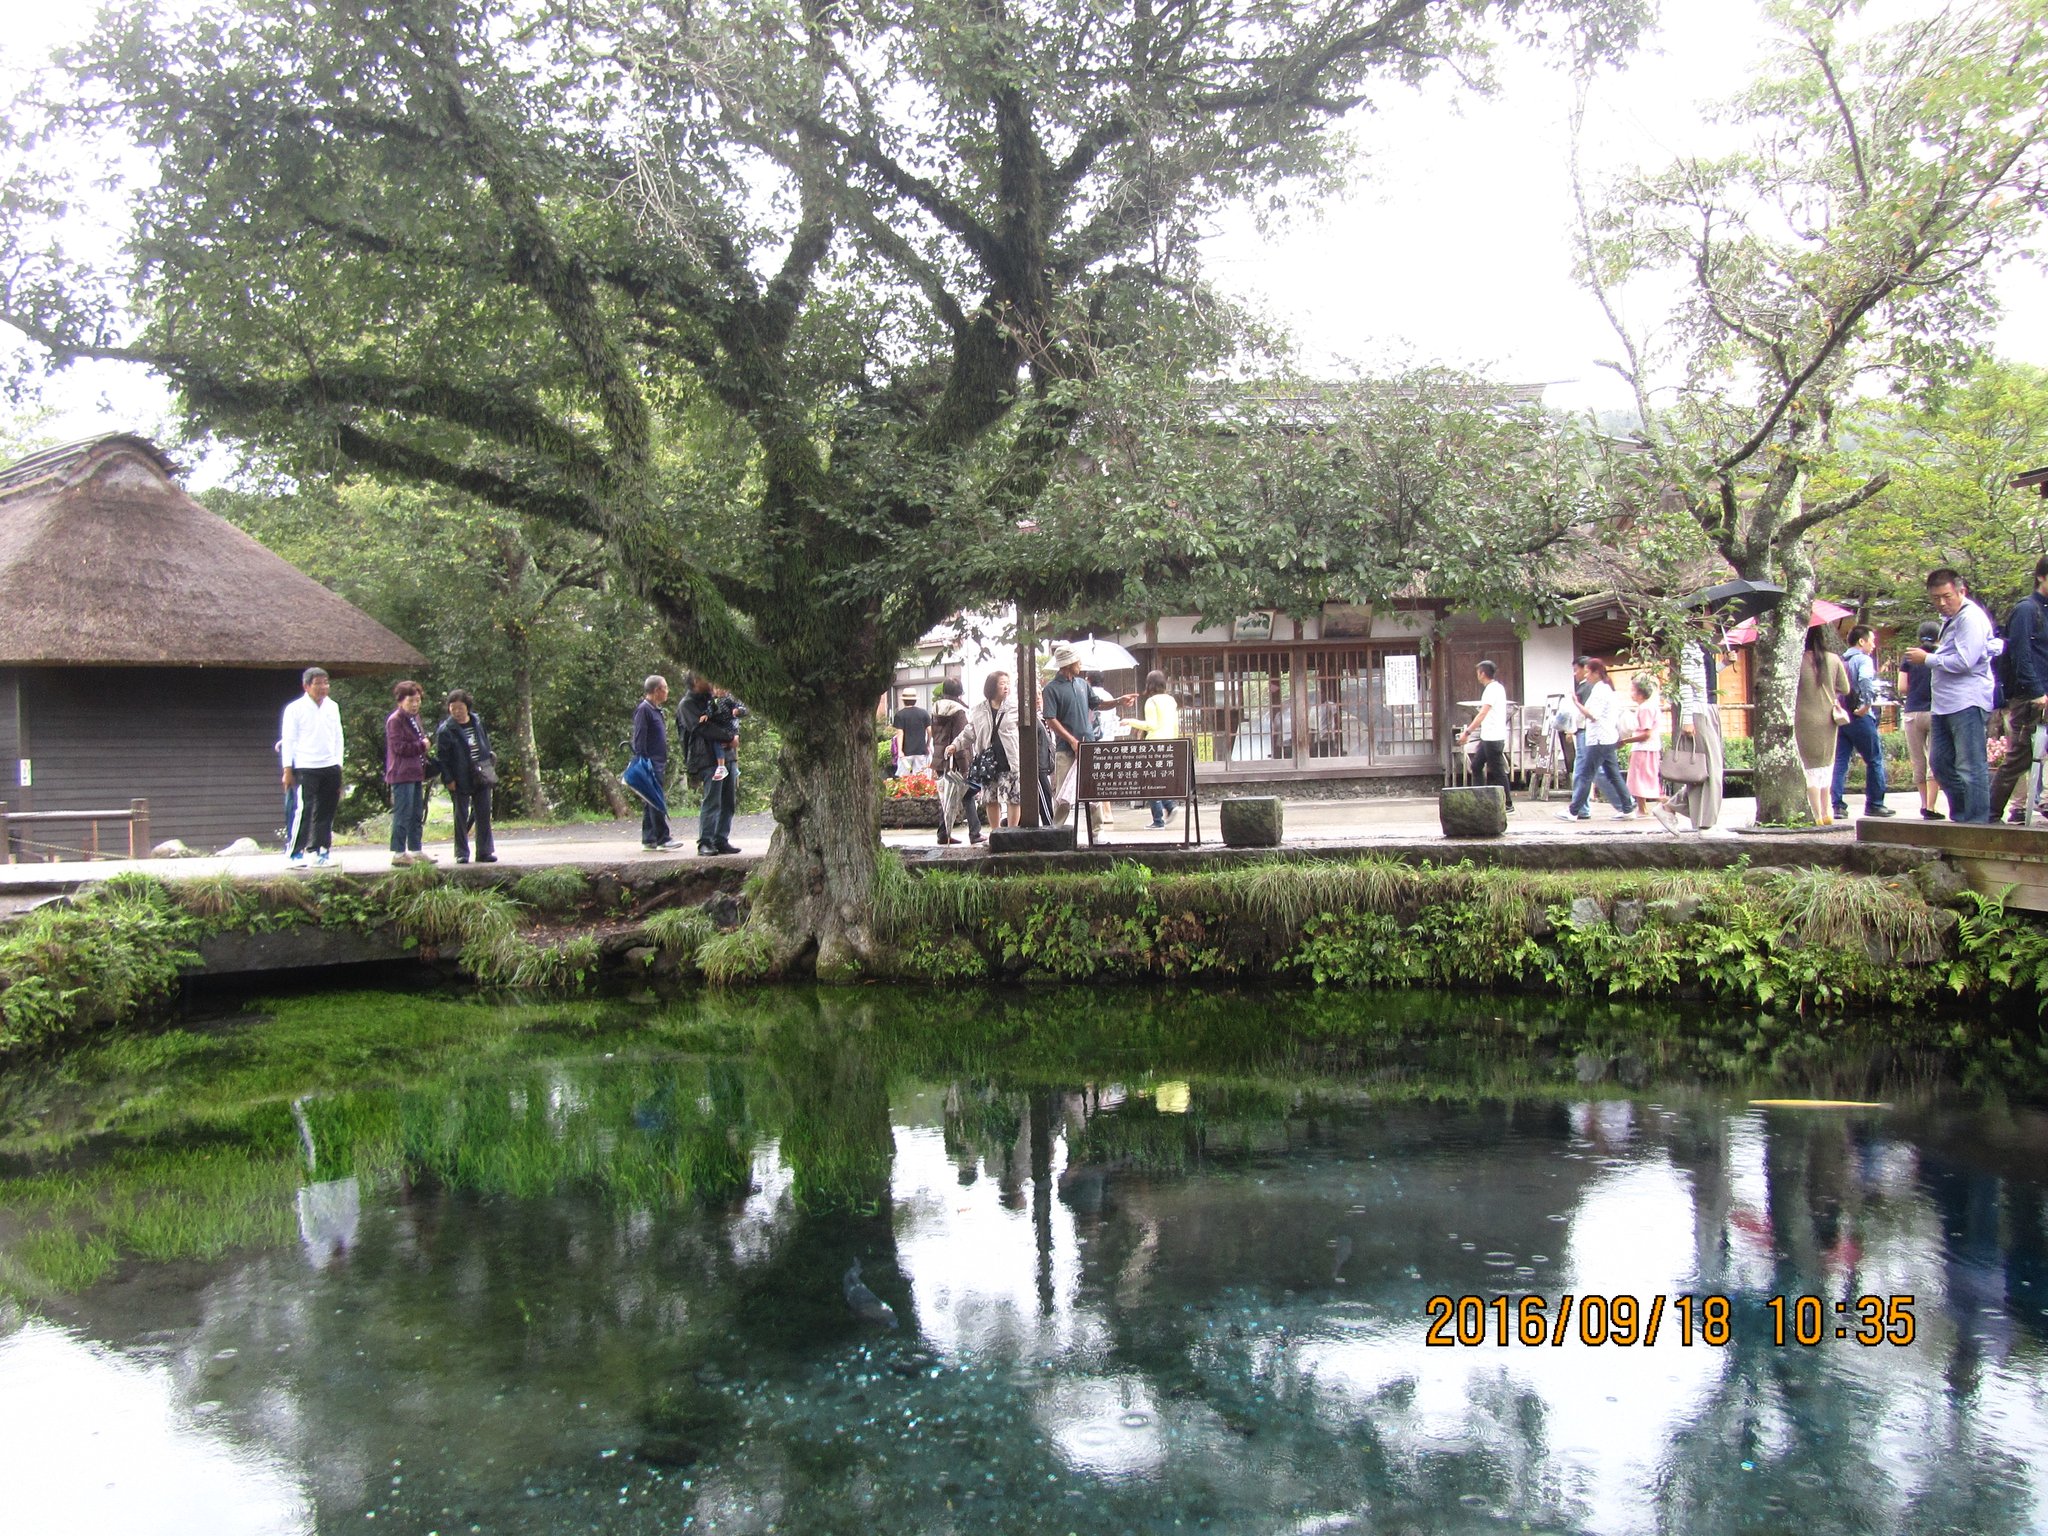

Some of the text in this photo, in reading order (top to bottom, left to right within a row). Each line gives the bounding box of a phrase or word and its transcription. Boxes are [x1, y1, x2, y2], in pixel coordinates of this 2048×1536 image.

[1093, 745, 1174, 754] 池への硬貨投入禁止
